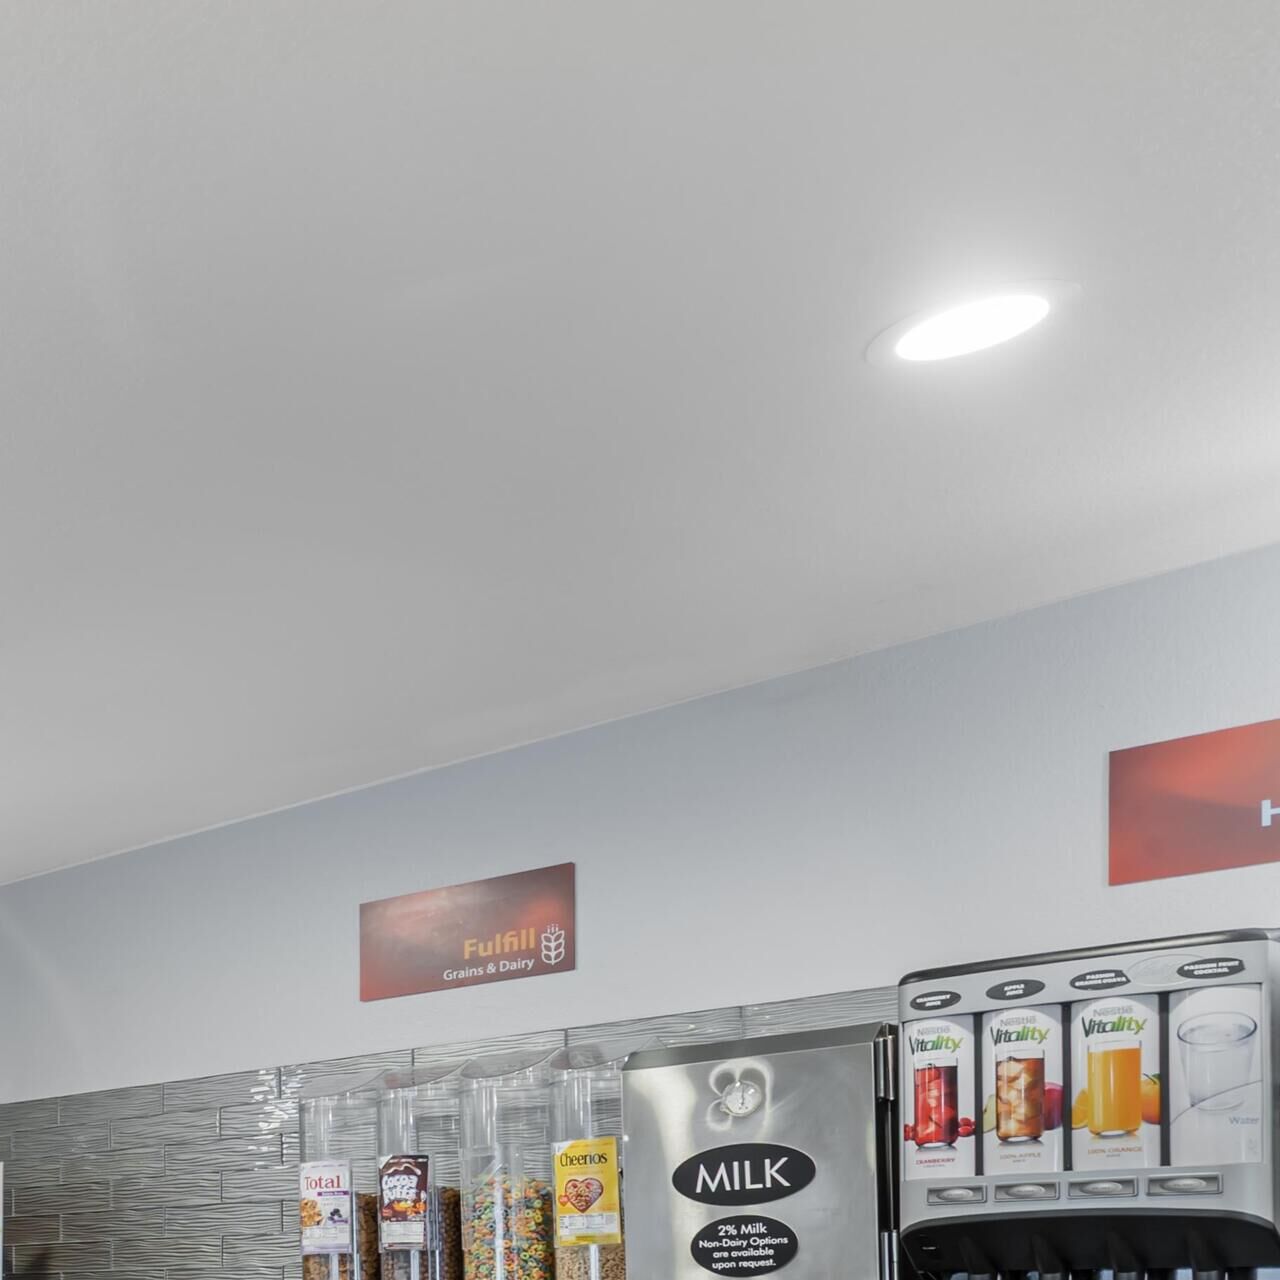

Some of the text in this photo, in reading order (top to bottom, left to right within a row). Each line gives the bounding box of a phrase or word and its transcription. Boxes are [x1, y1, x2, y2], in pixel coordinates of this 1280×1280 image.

[463, 927, 536, 961] Fulfill
[443, 958, 536, 981] Grains & Dairy
[1081, 1015, 1148, 1038] Vitality
[990, 1025, 1051, 1046] Vitality
[909, 1035, 965, 1056] Vitality
[1229, 1116, 1260, 1125] Water
[560, 1152, 608, 1167] Cheerios
[304, 1175, 341, 1190] Total
[695, 1157, 791, 1193] MILK
[717, 1222, 768, 1236] 2% Milk
[698, 1236, 789, 1250] Non-Dairy Options
[712, 1247, 775, 1259] are available
[712, 1259, 777, 1271] upon request.
